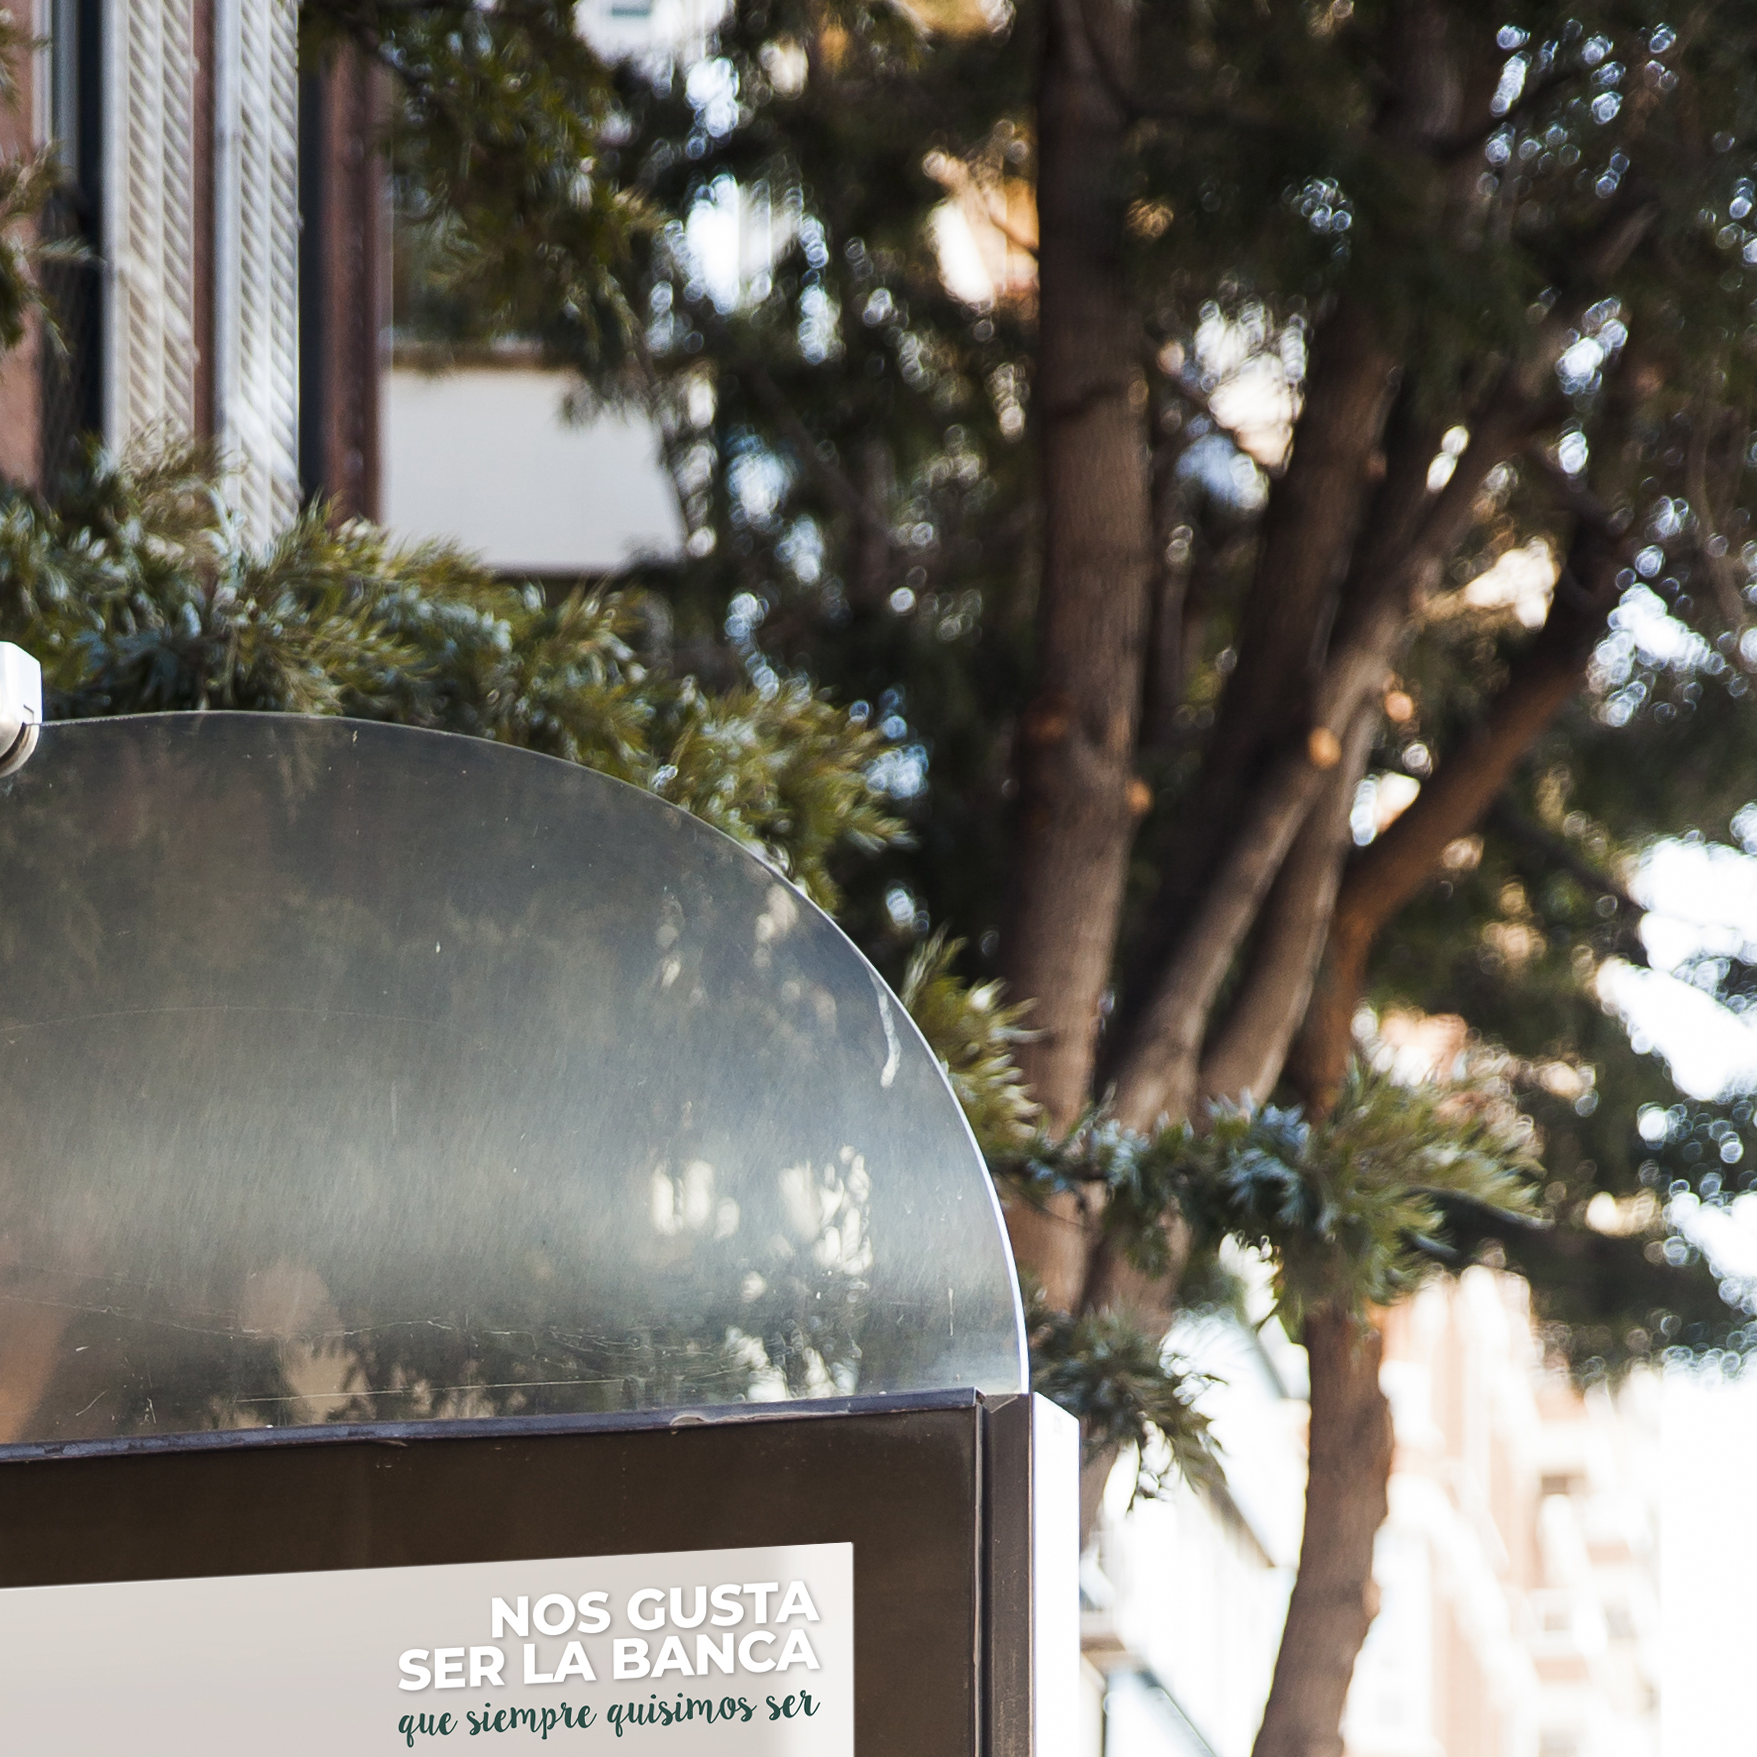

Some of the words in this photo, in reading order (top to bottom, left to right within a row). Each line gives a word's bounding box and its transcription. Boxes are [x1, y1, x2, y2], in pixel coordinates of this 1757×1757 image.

[491, 1591, 611, 1639] NOS
[627, 1580, 820, 1631] GUSTA
[398, 1645, 505, 1691] SER
[523, 1640, 597, 1685] LA
[613, 1628, 820, 1680] BANCA
[398, 1712, 458, 1748] que
[466, 1701, 598, 1740] siempre
[606, 1692, 758, 1738] quisimos
[765, 1689, 821, 1721] ser
